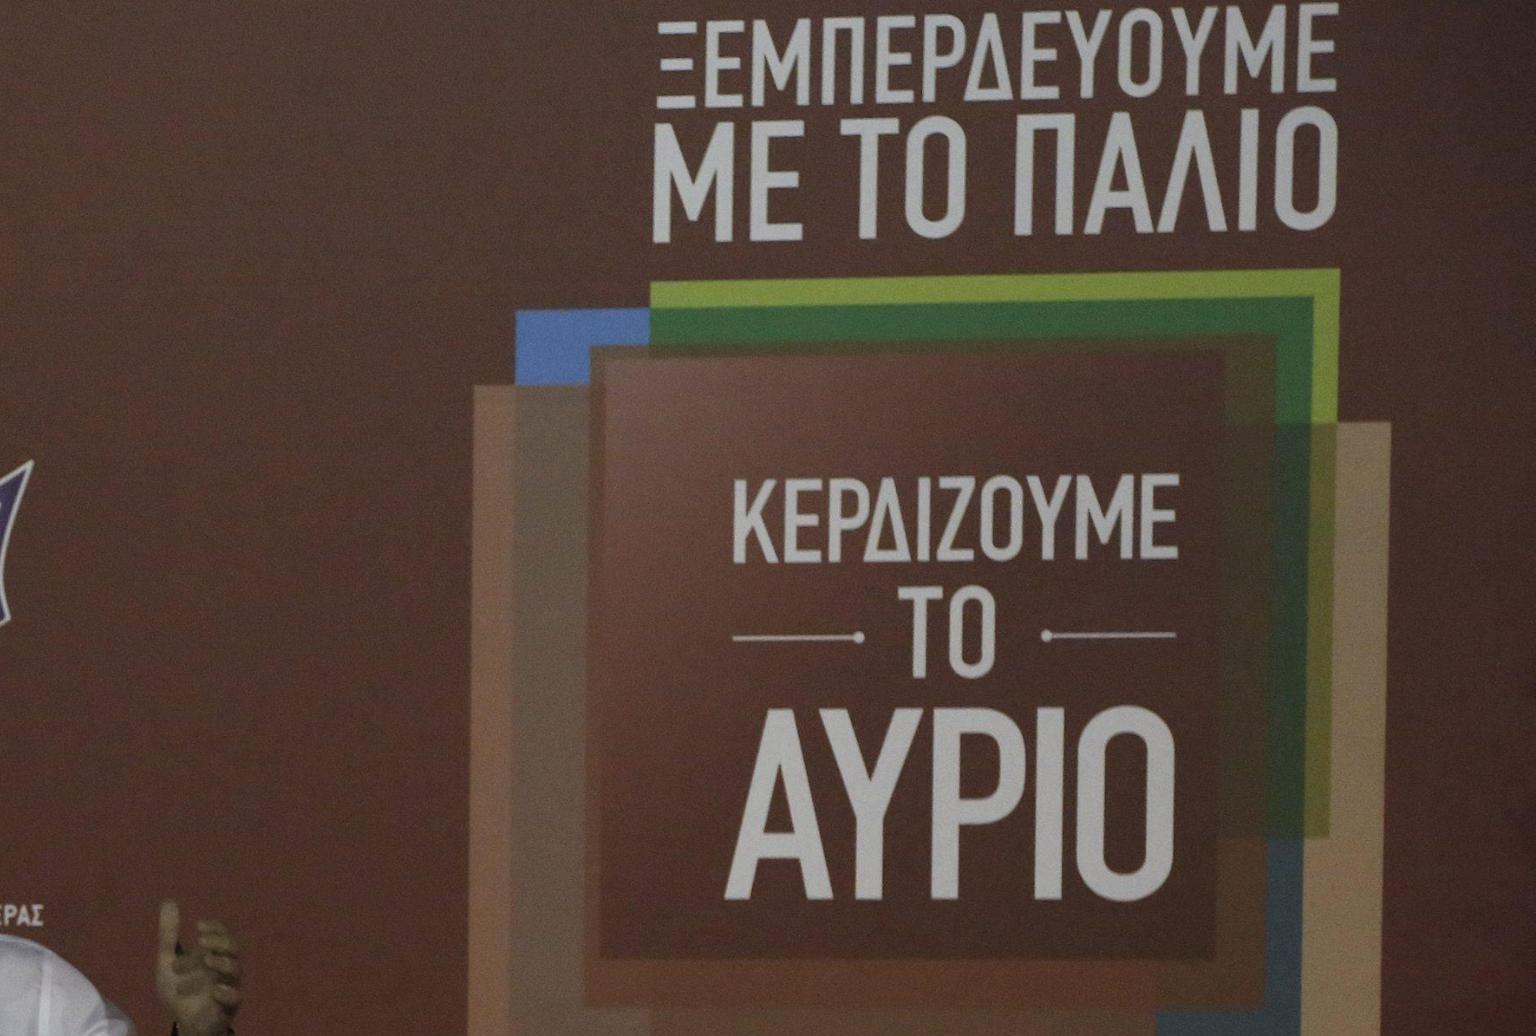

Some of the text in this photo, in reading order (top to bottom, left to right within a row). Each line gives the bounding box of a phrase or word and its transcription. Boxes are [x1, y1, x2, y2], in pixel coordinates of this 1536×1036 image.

[657, 3, 1339, 109] ΞΕΜΠΕΡΔΕΥΟΥΜΕ
[653, 106, 1339, 243] ΜΕ ΤΟ ΠΑΛΙΟ
[732, 473, 1180, 564] ΚΕΡΔΙΖΟΥΜΕ
[897, 584, 996, 679] ΤΟ
[724, 704, 1176, 902] ΑΥΡΙΟ
